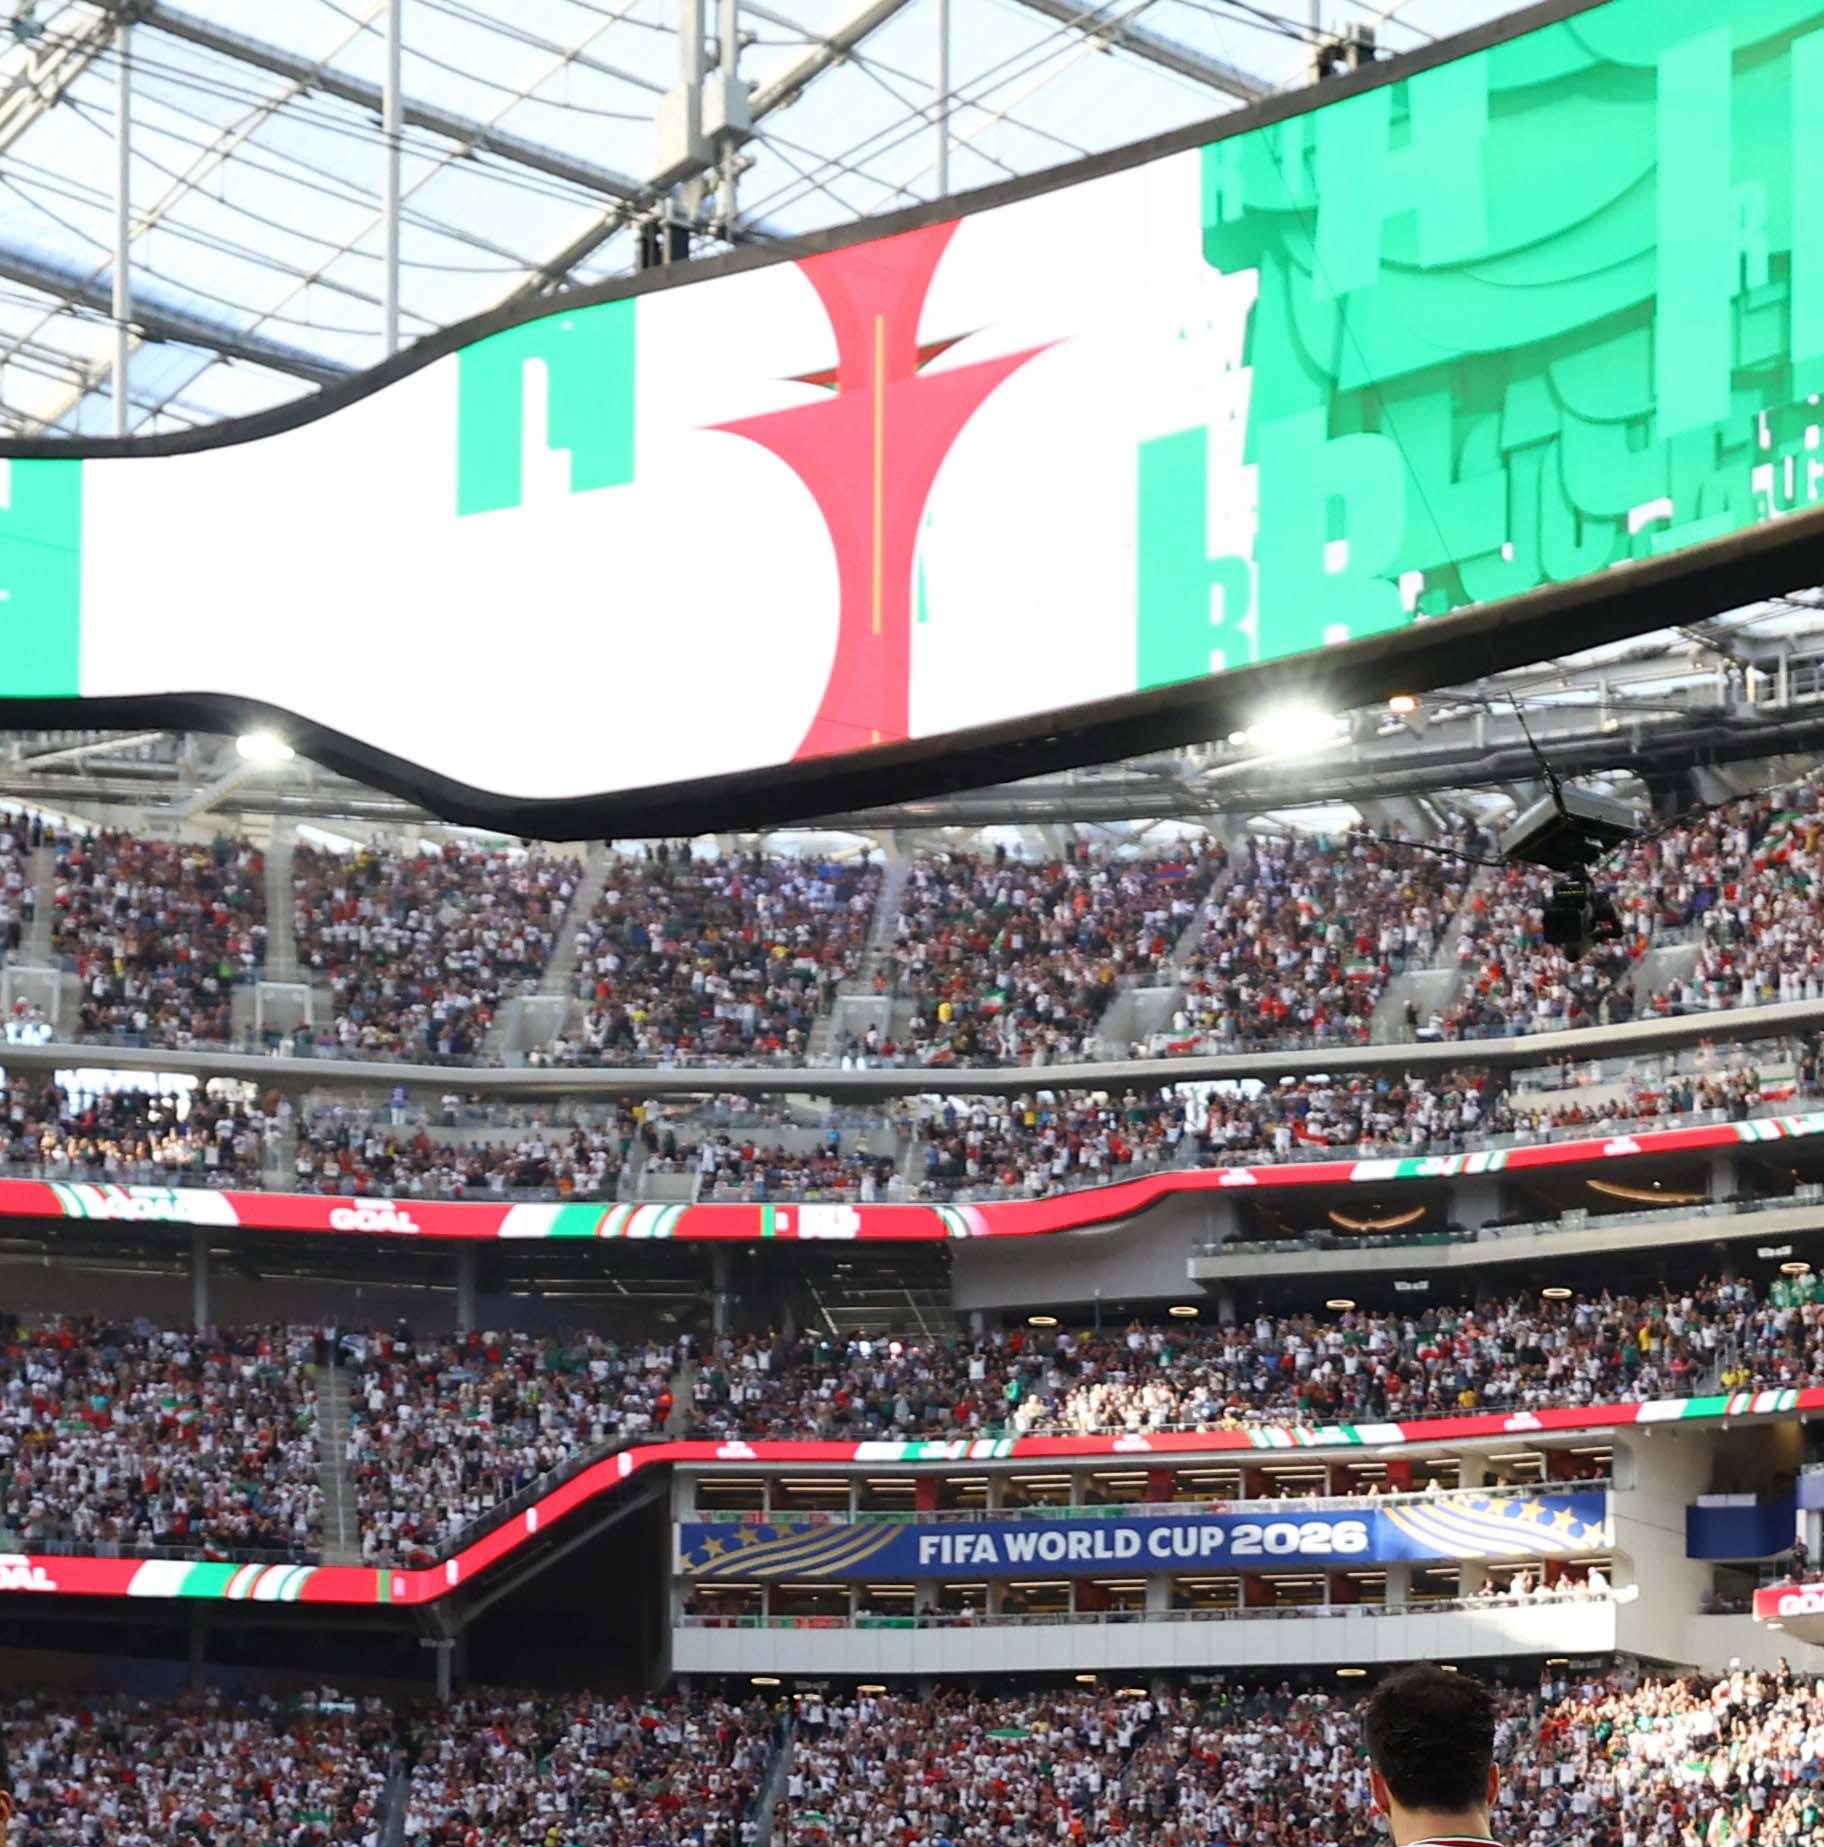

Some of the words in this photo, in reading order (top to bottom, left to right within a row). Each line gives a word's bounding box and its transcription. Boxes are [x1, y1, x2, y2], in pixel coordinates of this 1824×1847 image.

[329, 1207, 420, 1234] GOAL
[918, 1533, 997, 1565] FIFA
[1008, 1526, 1141, 1561] WORLD
[1146, 1525, 1225, 1557] CUP
[1229, 1520, 1369, 1556] 2026
